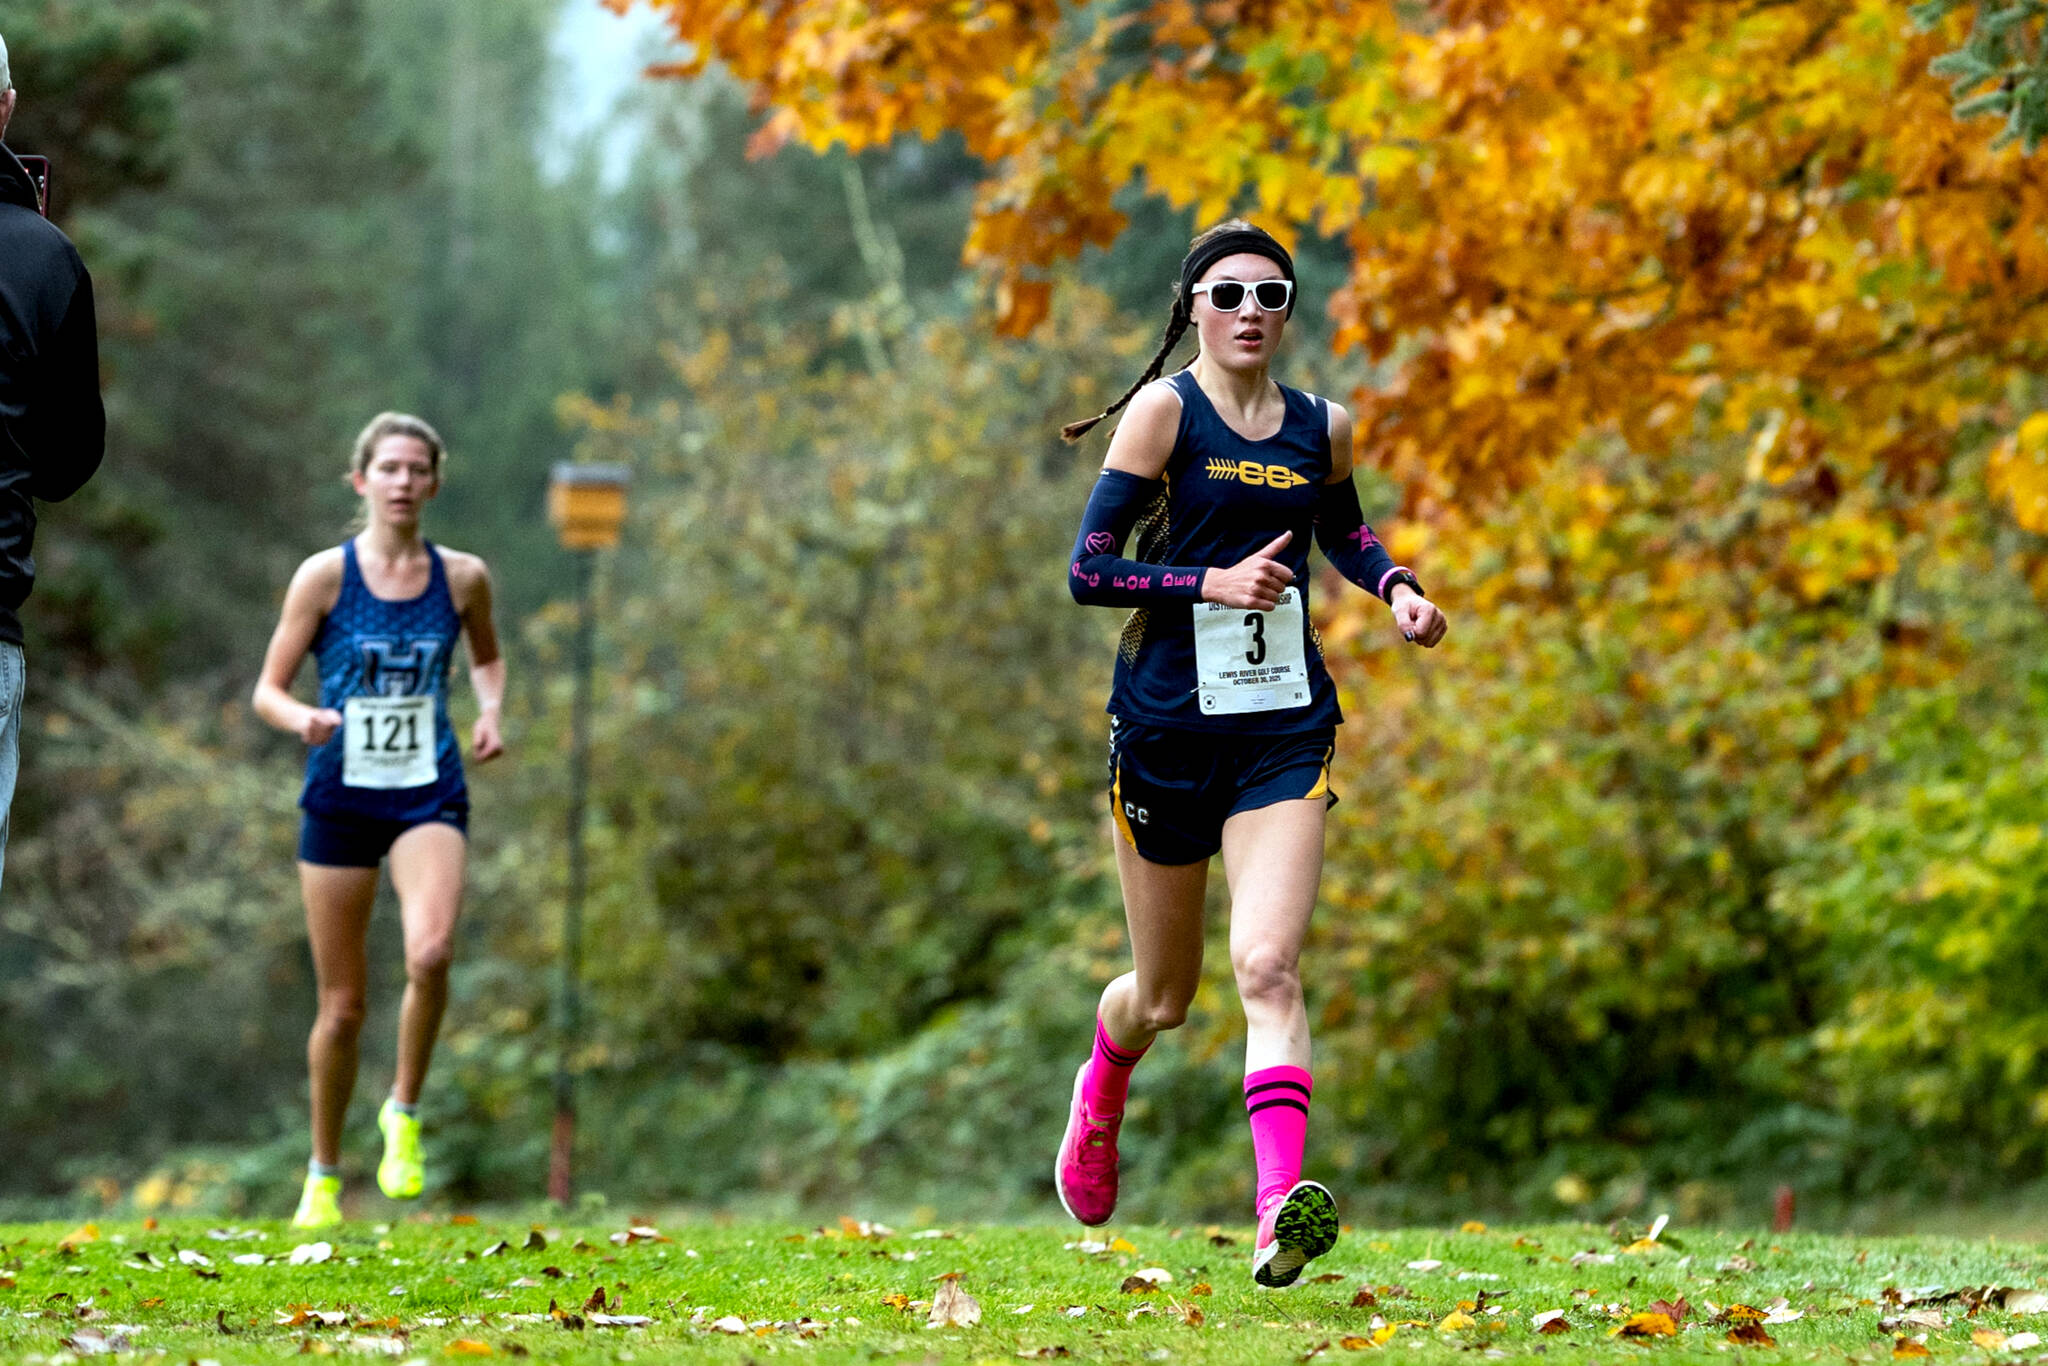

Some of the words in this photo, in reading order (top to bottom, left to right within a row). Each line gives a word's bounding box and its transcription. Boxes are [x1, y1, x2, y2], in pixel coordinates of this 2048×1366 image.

[1113, 574, 1151, 590] FOR
[1162, 573, 1198, 587] DES
[1244, 612, 1266, 666] 3
[1218, 670, 1238, 679] LEWIS
[1239, 669, 1257, 678] RIVER
[1257, 667, 1270, 676] GOLF
[1270, 665, 1291, 674] COURSE
[1232, 677, 1259, 686] OCTOBER
[363, 713, 419, 752] 121
